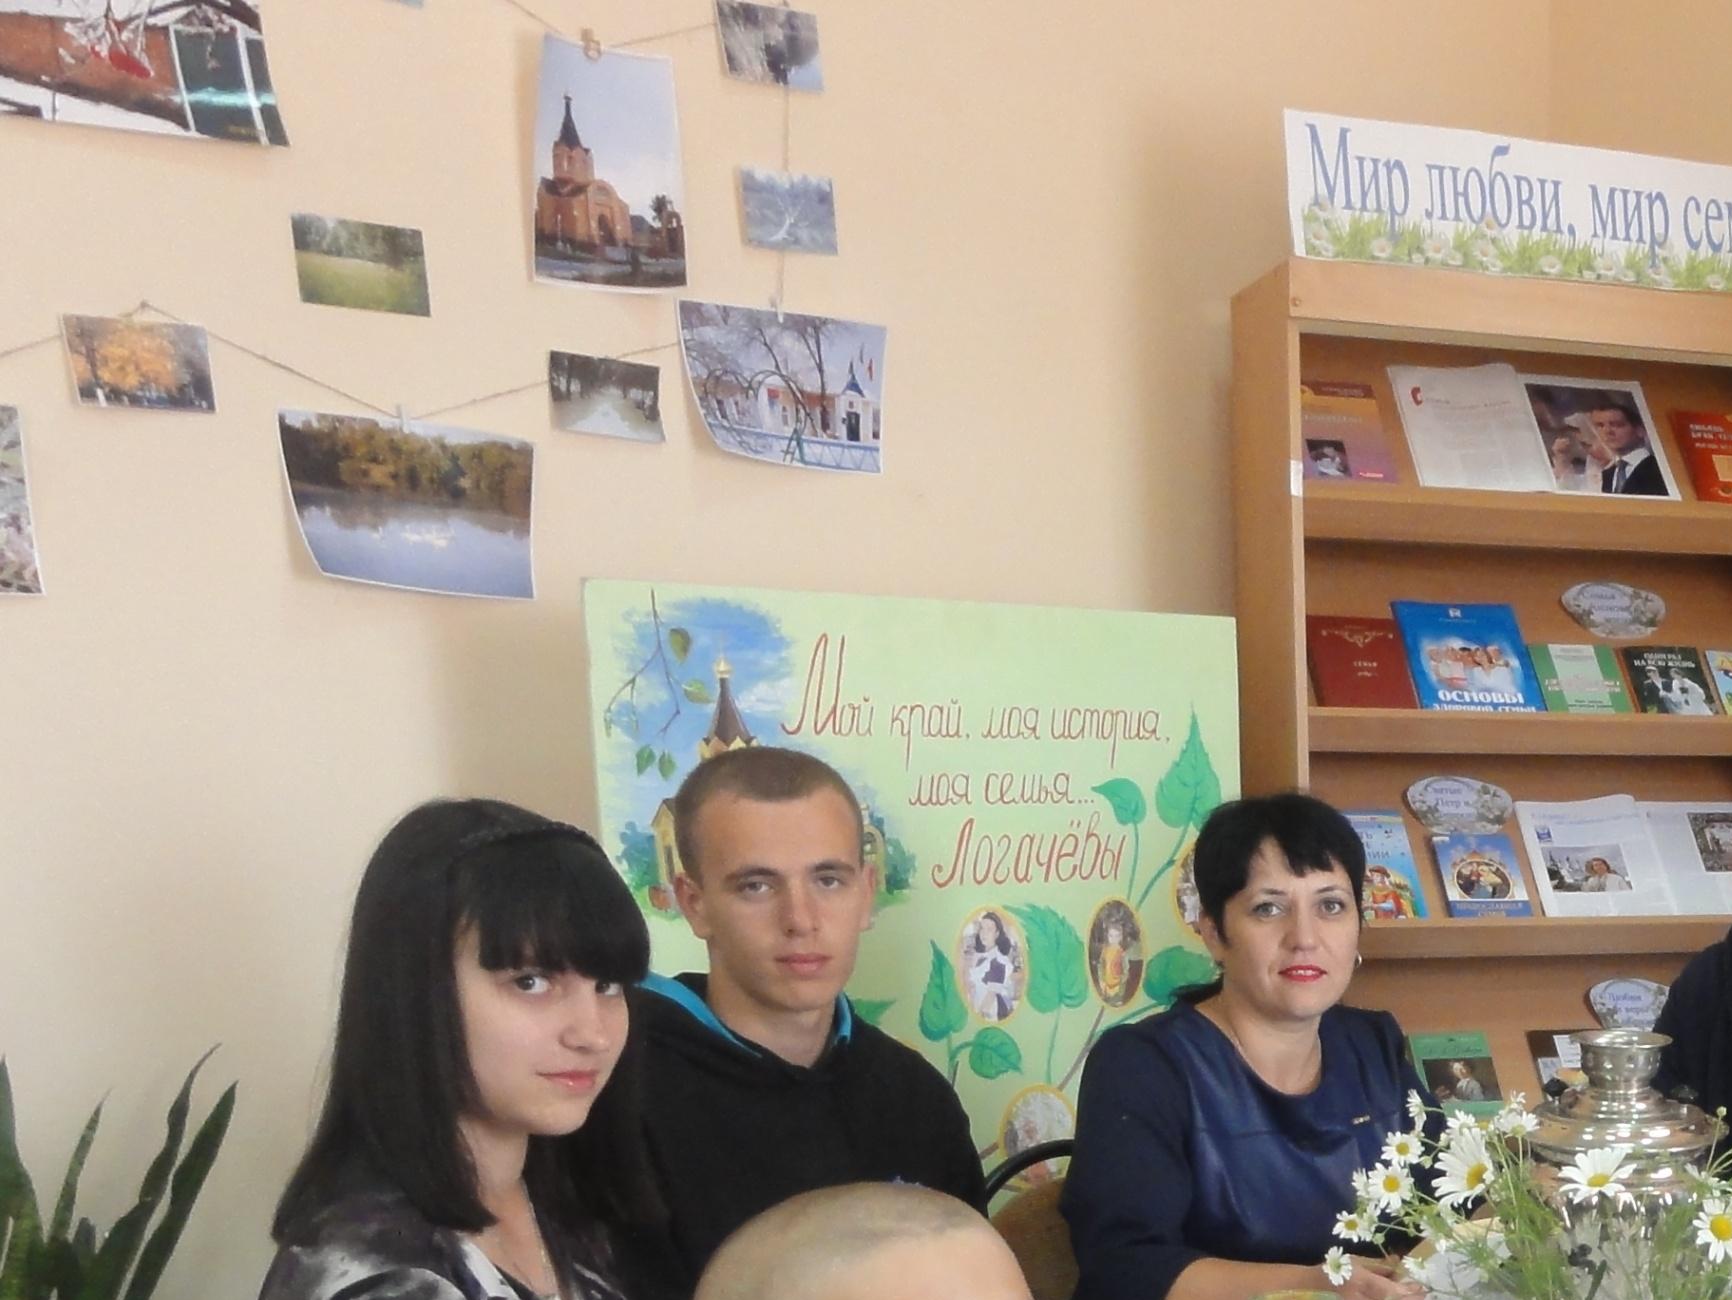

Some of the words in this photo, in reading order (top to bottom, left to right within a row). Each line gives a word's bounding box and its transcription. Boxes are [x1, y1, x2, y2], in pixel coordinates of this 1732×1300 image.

[1305, 122, 1411, 233] Мир
[1425, 144, 1576, 241] любви,
[1588, 182, 1670, 266] мир
[780, 632, 874, 737] Мой
[981, 705, 1041, 741] моя
[1437, 689, 1525, 704] ОСНОВЫ
[909, 772, 971, 807] моя
[931, 811, 1127, 888] Логачёвы
